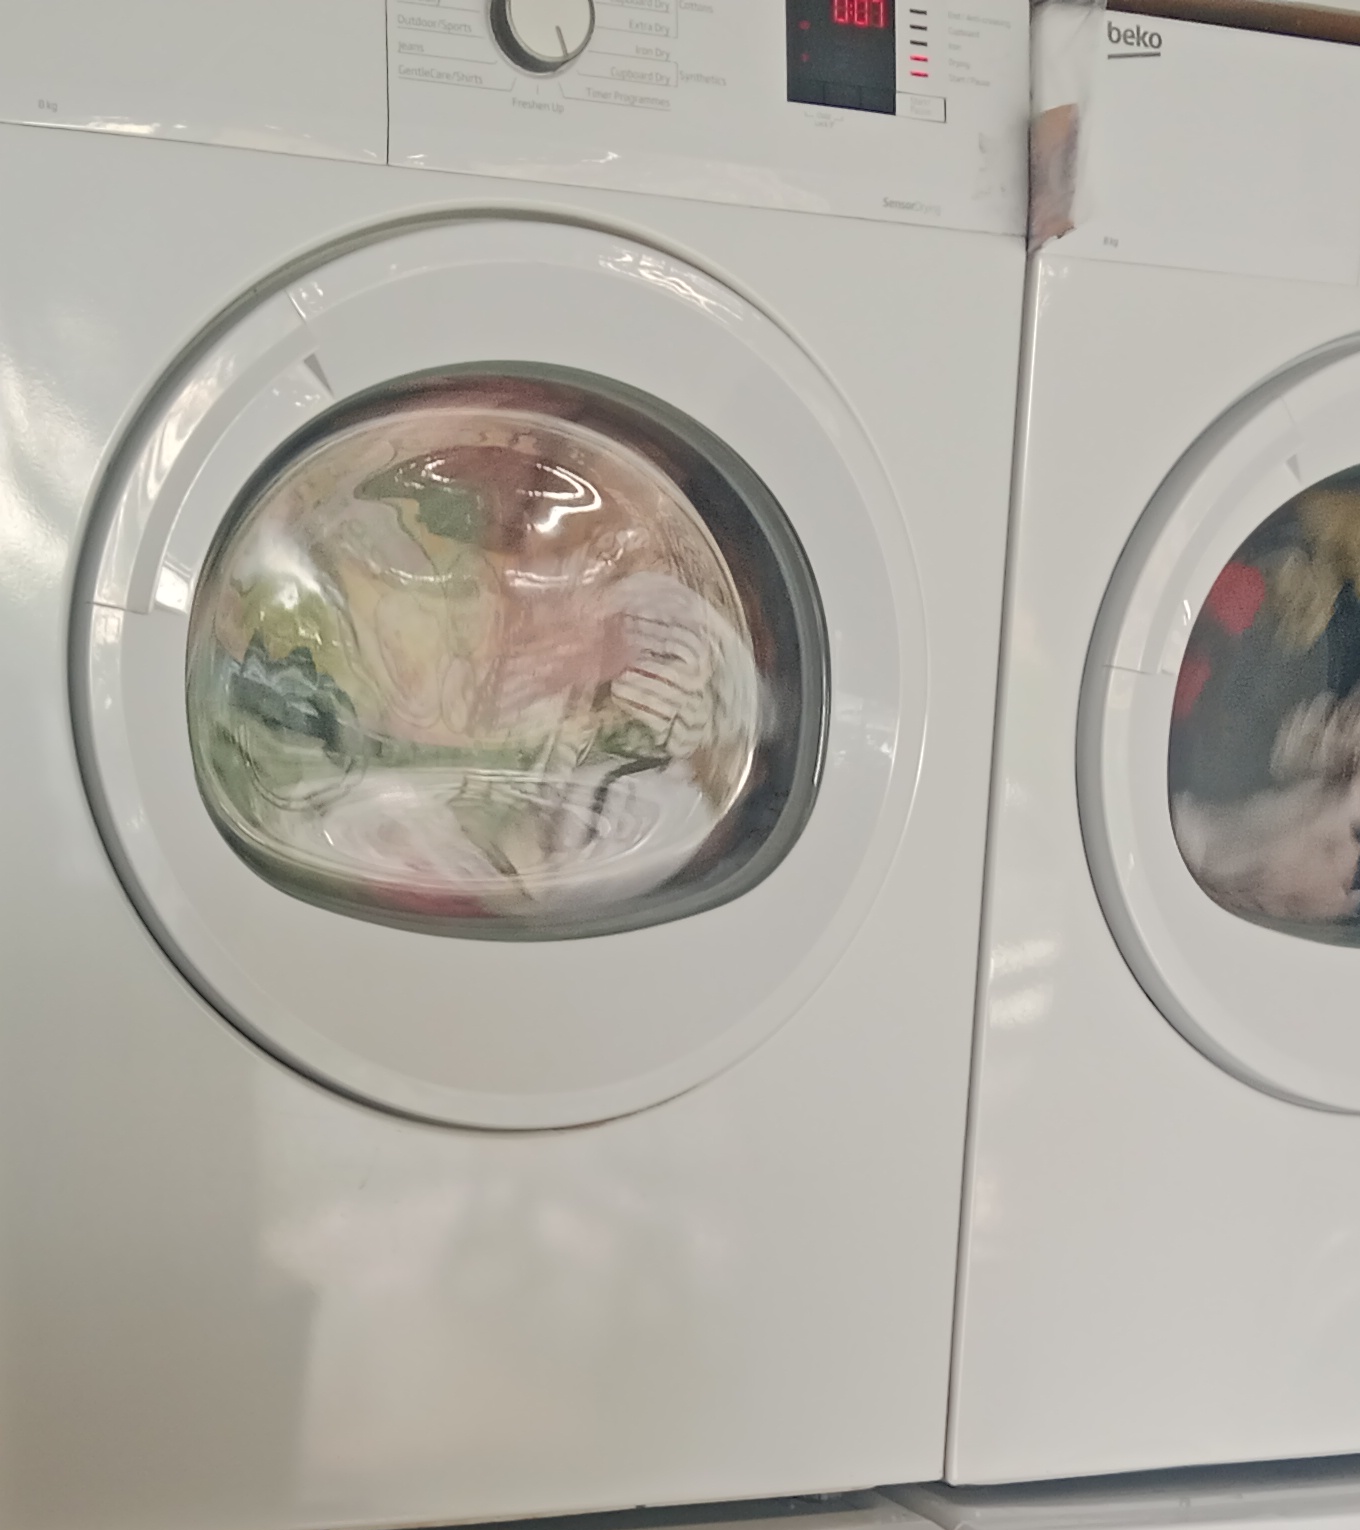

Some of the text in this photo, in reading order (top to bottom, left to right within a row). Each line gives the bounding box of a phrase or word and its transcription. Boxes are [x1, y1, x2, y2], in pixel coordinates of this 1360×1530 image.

[397, 14, 473, 34] Outdoor/Sports
[629, 19, 671, 37] Extra Dry
[1106, 20, 1163, 50] beko
[398, 41, 425, 53] Jeans
[635, 45, 671, 62] Iron Dry
[398, 65, 484, 85] GentleCare/Shirts
[610, 66, 671, 87] Cupboard Dry
[679, 70, 727, 88] Synthetics
[586, 87, 612, 100] Timer
[512, 97, 565, 114] Freshen Up
